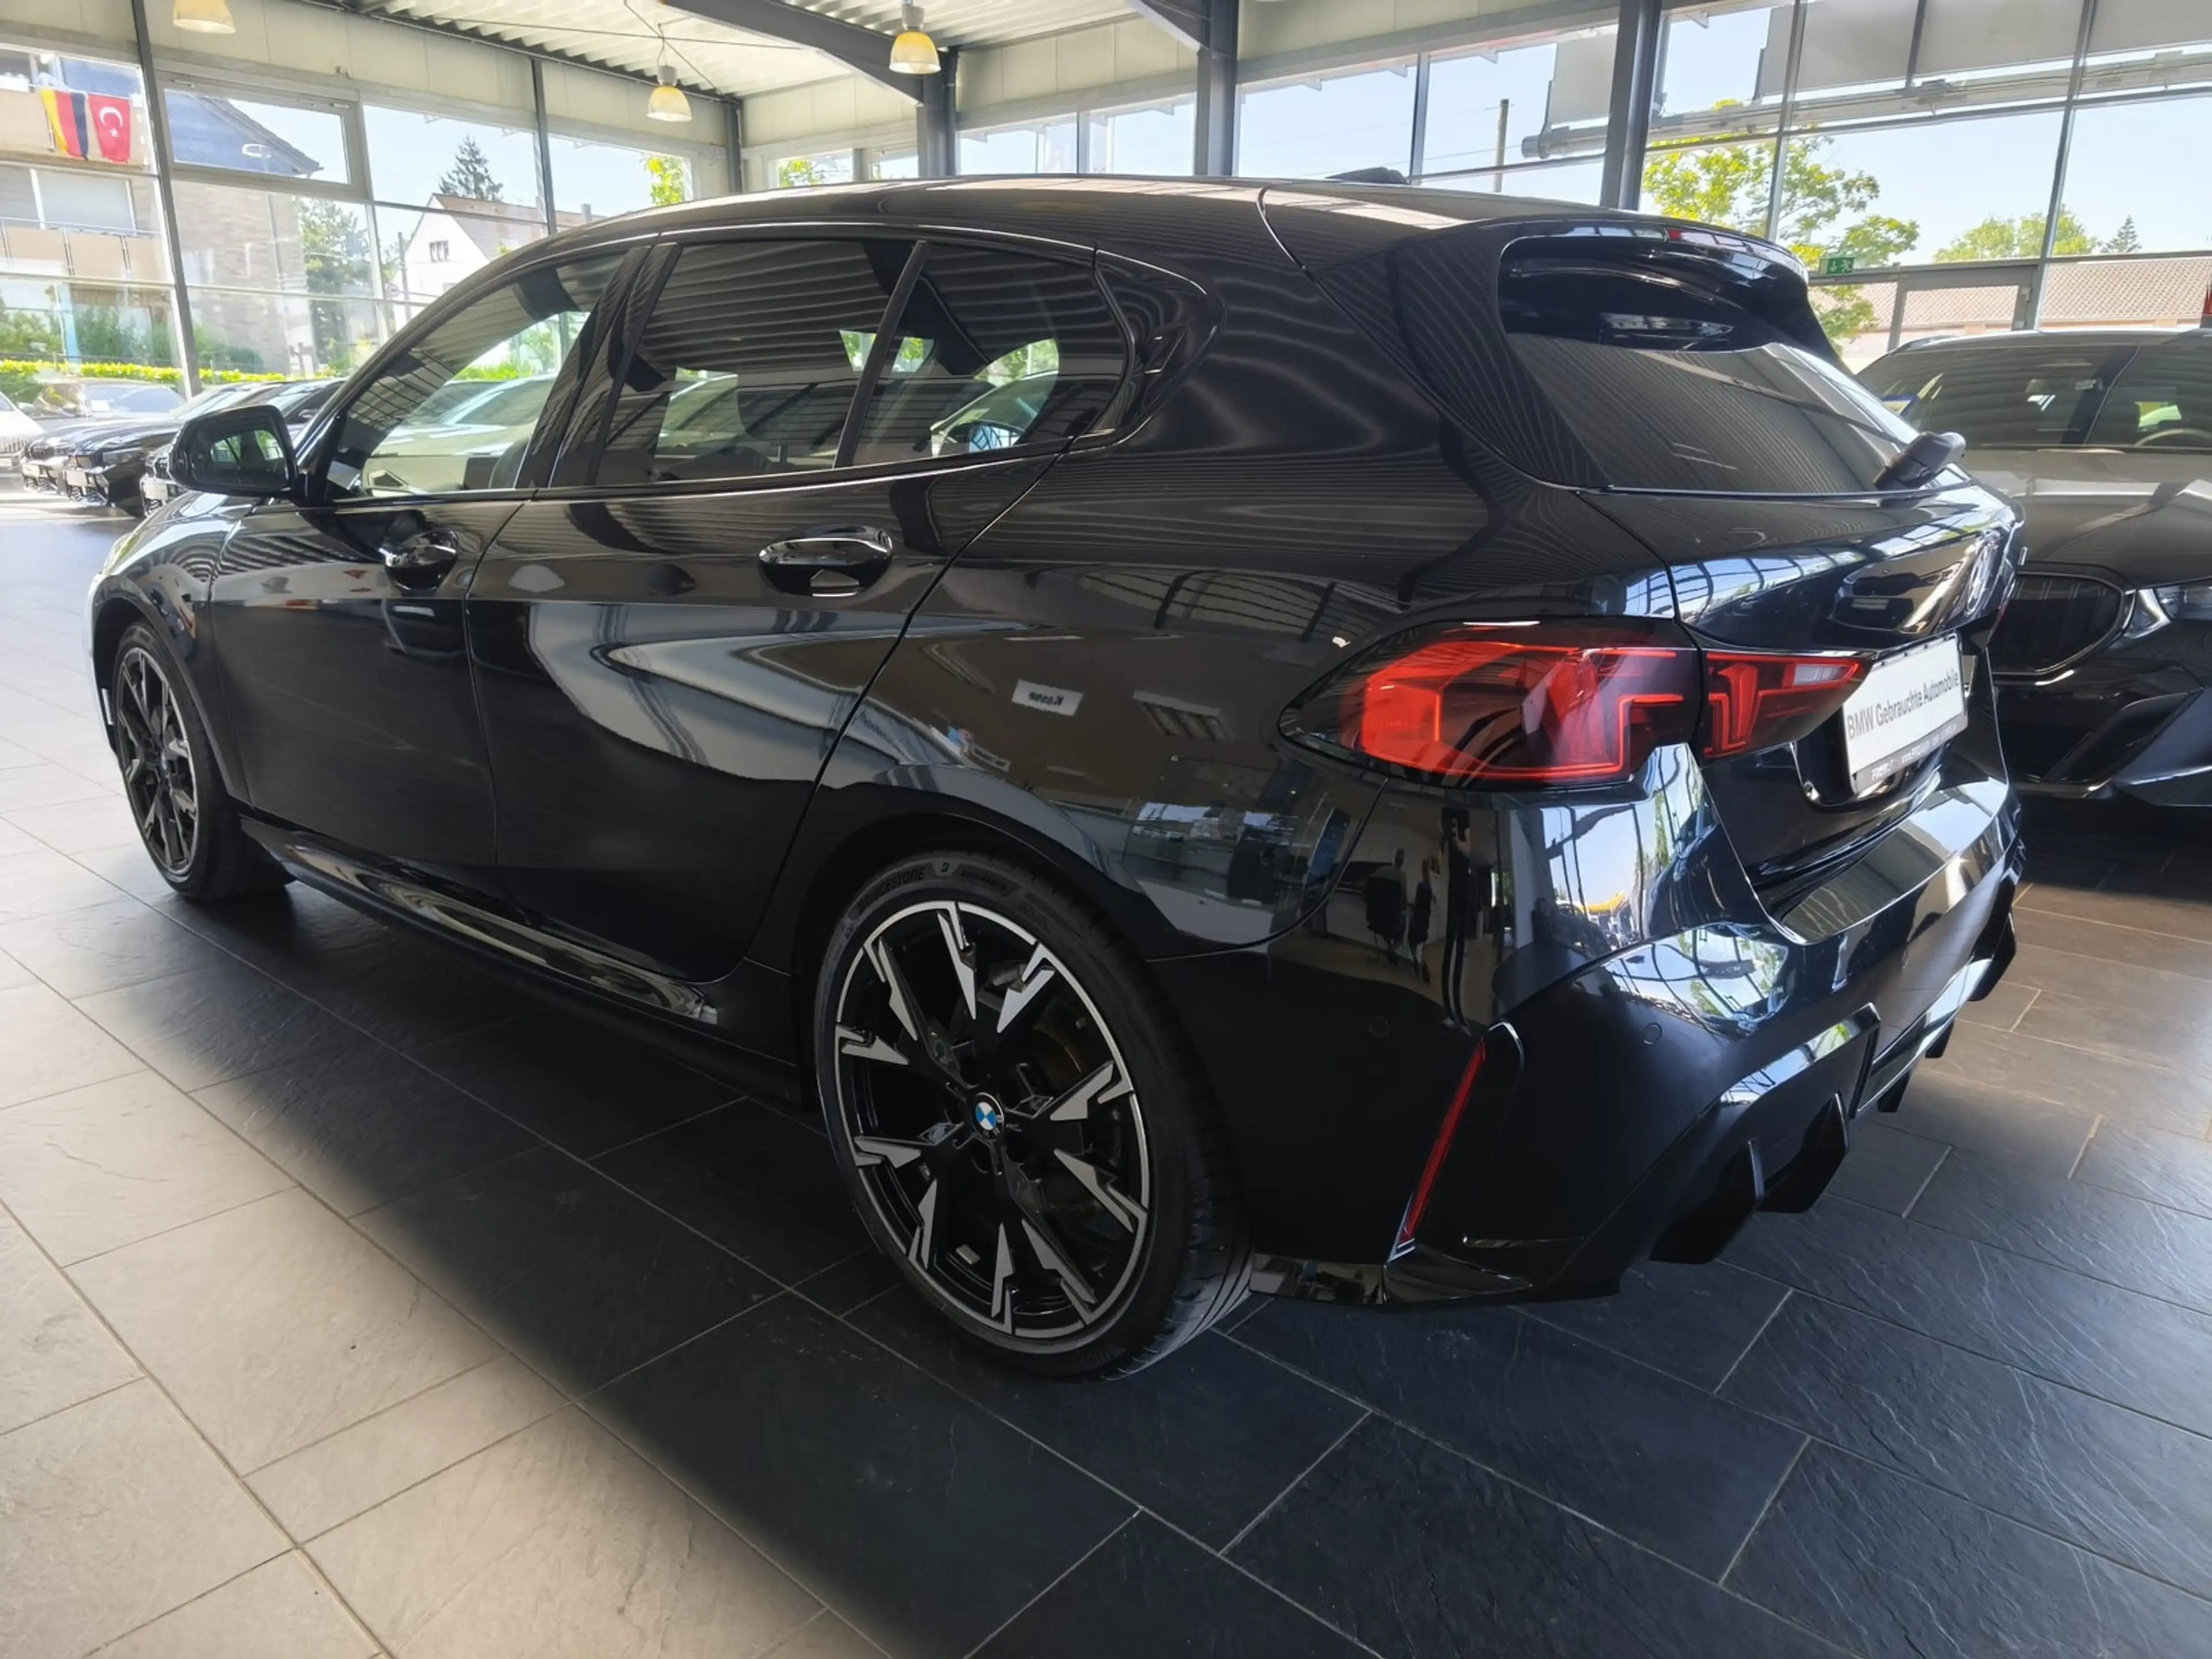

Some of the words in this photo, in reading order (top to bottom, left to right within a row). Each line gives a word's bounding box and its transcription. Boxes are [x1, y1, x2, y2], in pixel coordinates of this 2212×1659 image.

[1846, 705, 1874, 740] BMW
[1876, 690, 1923, 726] Gebrauchte
[1923, 666, 1959, 704] Automobile
